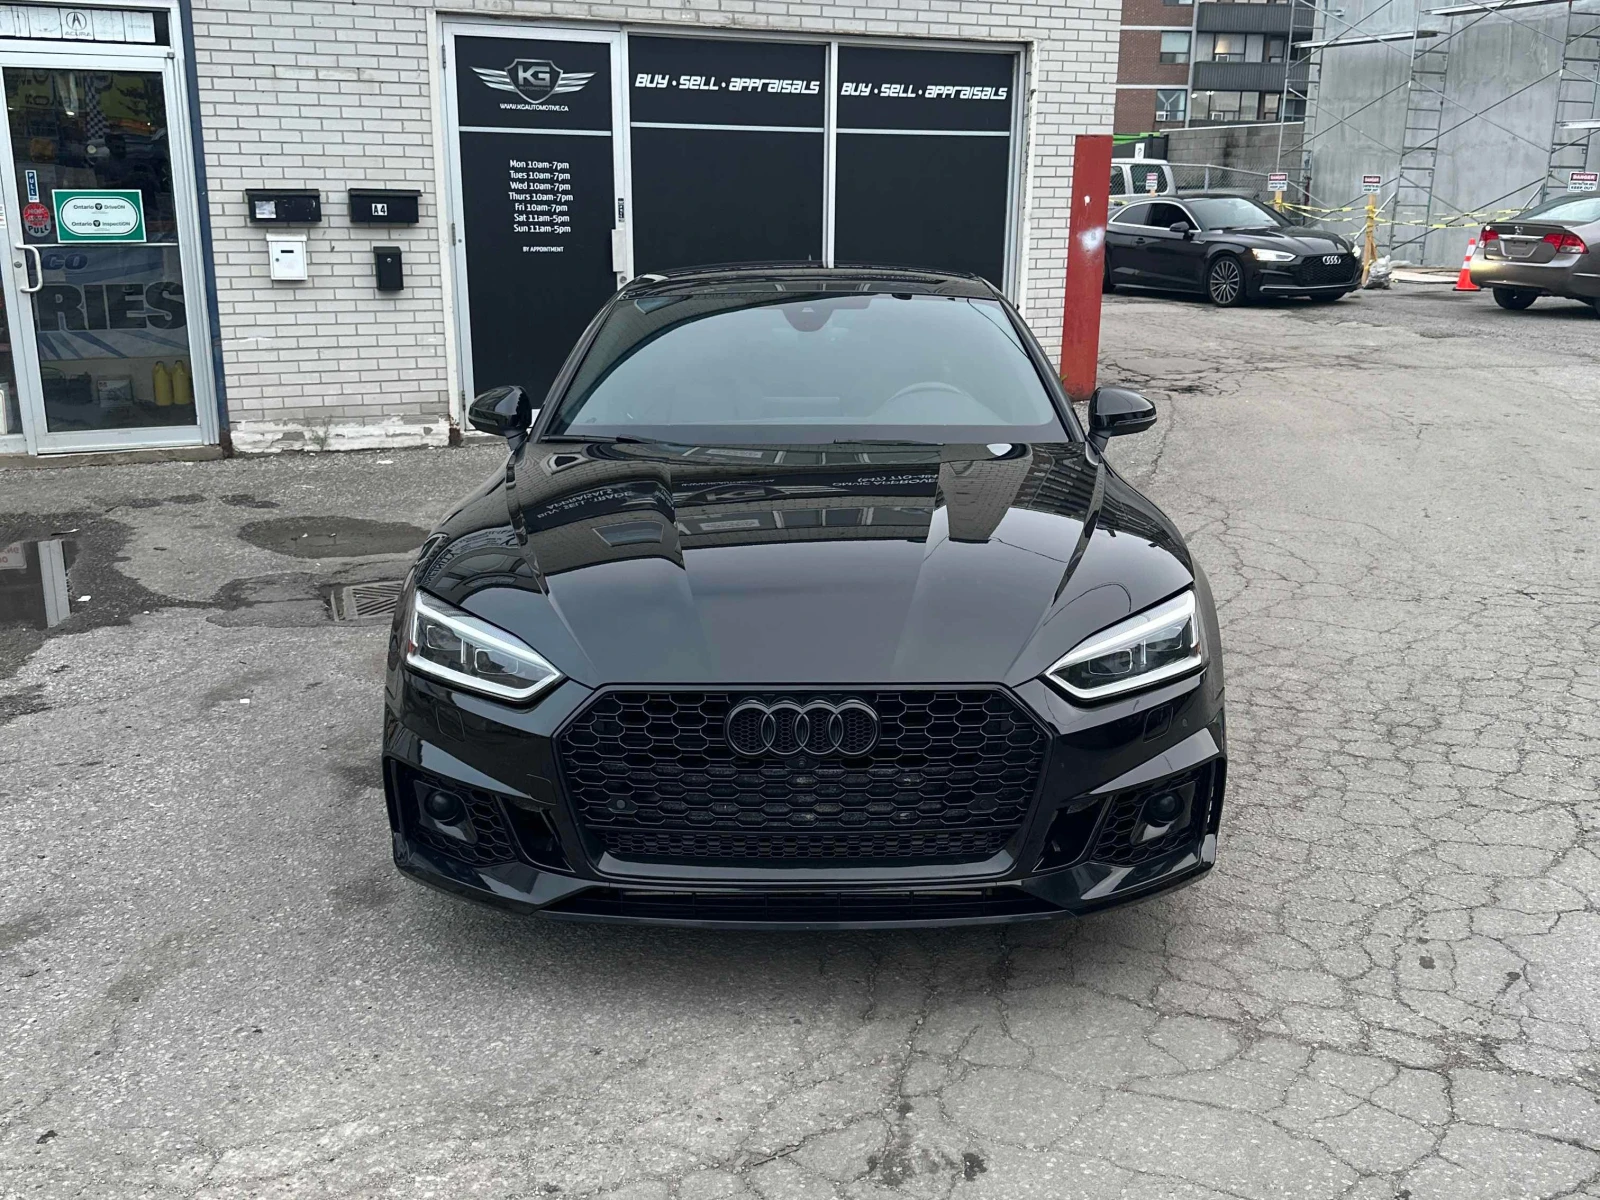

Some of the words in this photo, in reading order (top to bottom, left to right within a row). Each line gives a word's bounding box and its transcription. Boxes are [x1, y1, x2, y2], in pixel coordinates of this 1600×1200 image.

[518, 65, 551, 86] KG
[635, 73, 669, 88] BUY
[840, 82, 873, 97] BUY
[500, 103, 569, 112] WWW.KGAUTOMOTIVE.CA
[510, 159, 526, 168] Mon
[527, 161, 570, 171] 10am-7pm
[509, 170, 528, 179] Tues
[528, 171, 571, 181] 10am-7pm
[28, 172, 36, 195] PULL
[510, 181, 528, 190] Wed
[529, 182, 571, 192] 10am-7pm
[508, 191, 531, 200] Thurs
[531, 193, 574, 203] 10am-7pm
[515, 202, 525, 211] Fri
[526, 203, 568, 213] 10am-7pm
[513, 213, 527, 222] Sat
[528, 214, 570, 224] 11am-5pm
[28, 225, 49, 234] PULL
[513, 223, 528, 232] Sun
[529, 225, 571, 235] 11am-5pm
